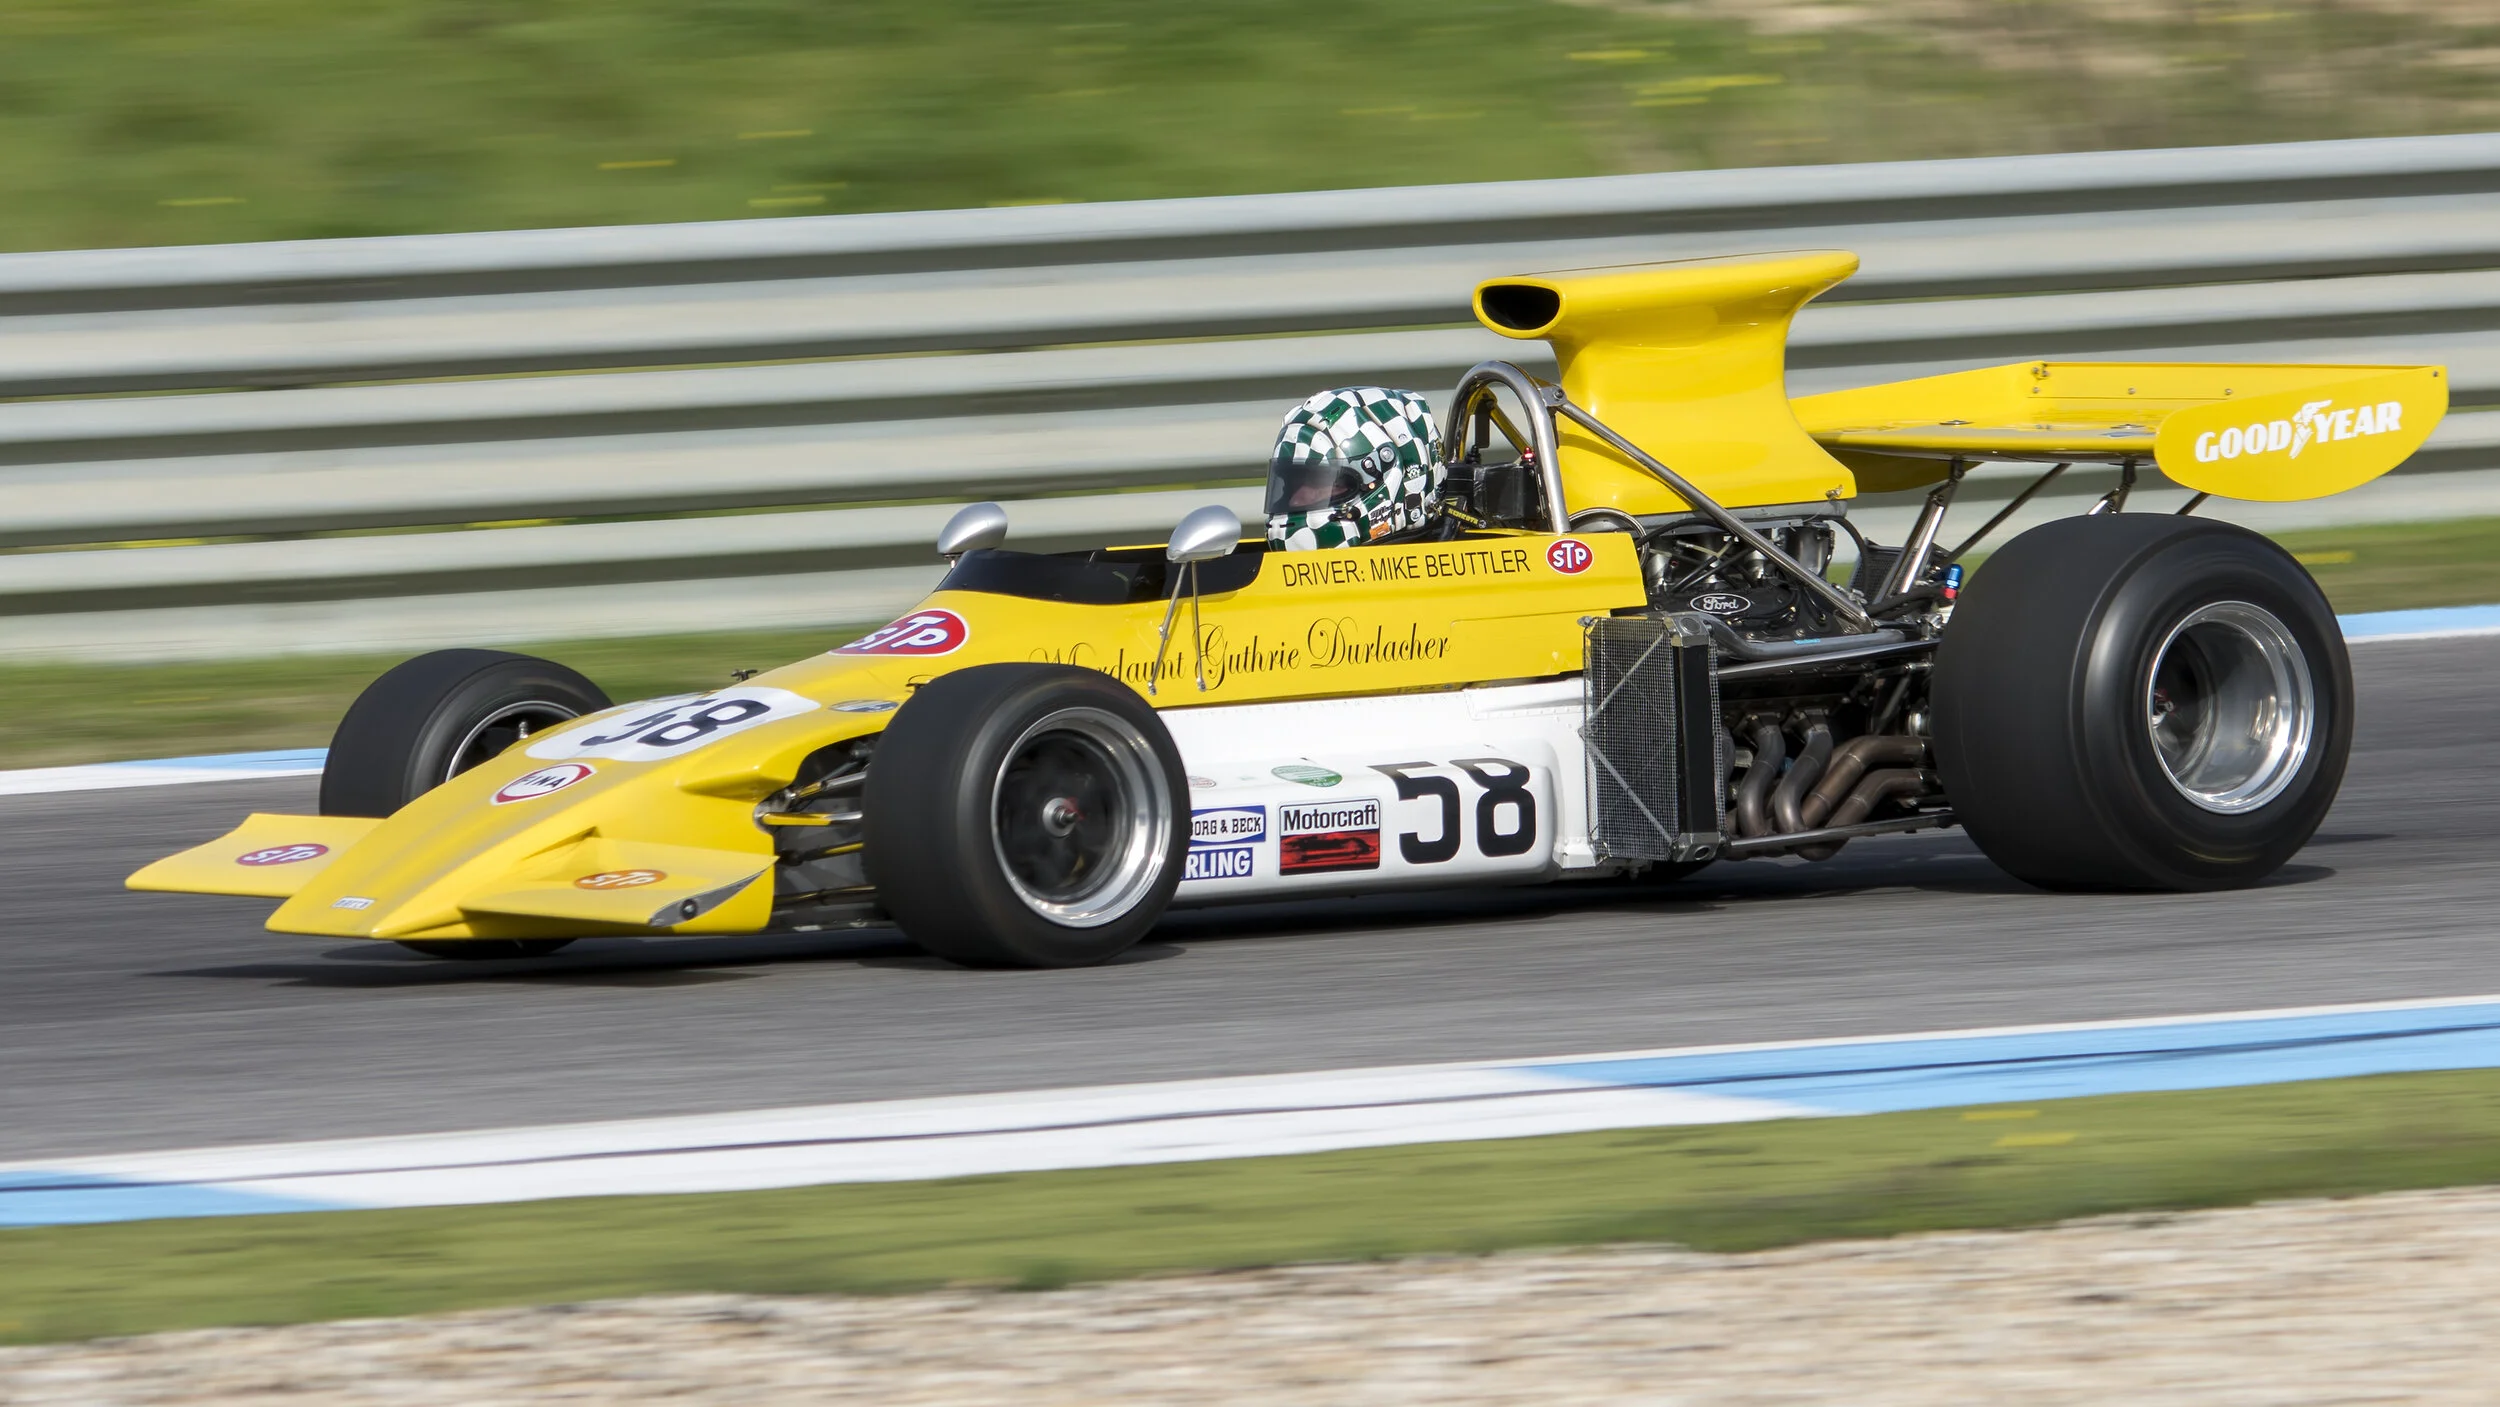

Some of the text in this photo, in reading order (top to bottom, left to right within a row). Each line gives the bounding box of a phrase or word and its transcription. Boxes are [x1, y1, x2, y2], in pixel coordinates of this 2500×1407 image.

[1282, 549, 1531, 587] DRIVER: MIKE BEUTTLER
[1552, 542, 1588, 570] STP
[1702, 596, 1740, 611] Ford
[842, 615, 949, 649] STP
[1028, 616, 1451, 691] daunt Guthrie Durlacher
[580, 698, 771, 747] 58
[1220, 819, 1228, 834] &
[1232, 816, 1262, 834] BECK
[1283, 804, 1377, 832] Motorcraft
[1366, 757, 1537, 865] 58
[242, 846, 319, 863] STP
[1182, 849, 1251, 879] RLING
[579, 871, 658, 887] STP
